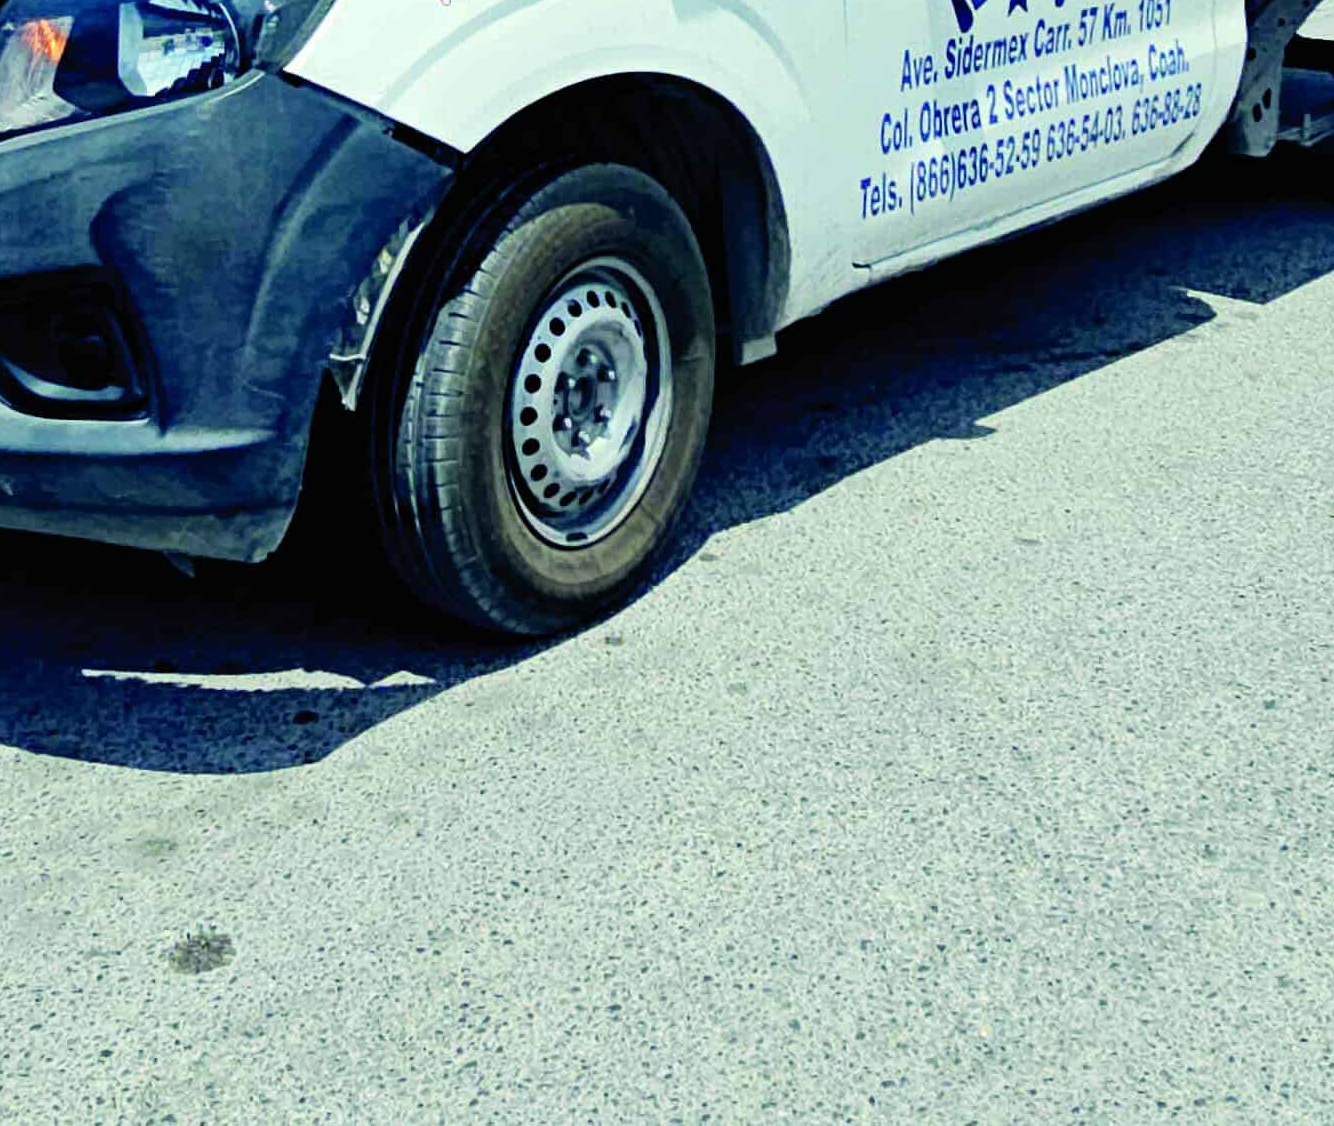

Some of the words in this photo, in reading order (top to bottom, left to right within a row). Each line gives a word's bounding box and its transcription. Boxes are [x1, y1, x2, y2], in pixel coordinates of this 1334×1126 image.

[900, 49, 938, 93] Ave.
[944, 32, 1029, 80] Sidermex
[1034, 18, 1071, 58] Carr.
[1078, 6, 1099, 47] 57
[1102, 2, 1131, 41] Km.
[881, 107, 913, 155] Col.
[919, 98, 982, 143] Obrera
[986, 84, 998, 125] 2
[1003, 74, 1059, 120] Sector
[1064, 55, 1144, 105] Monclova,
[1148, 38, 1190, 81] Coah.
[860, 171, 903, 219] Tels.
